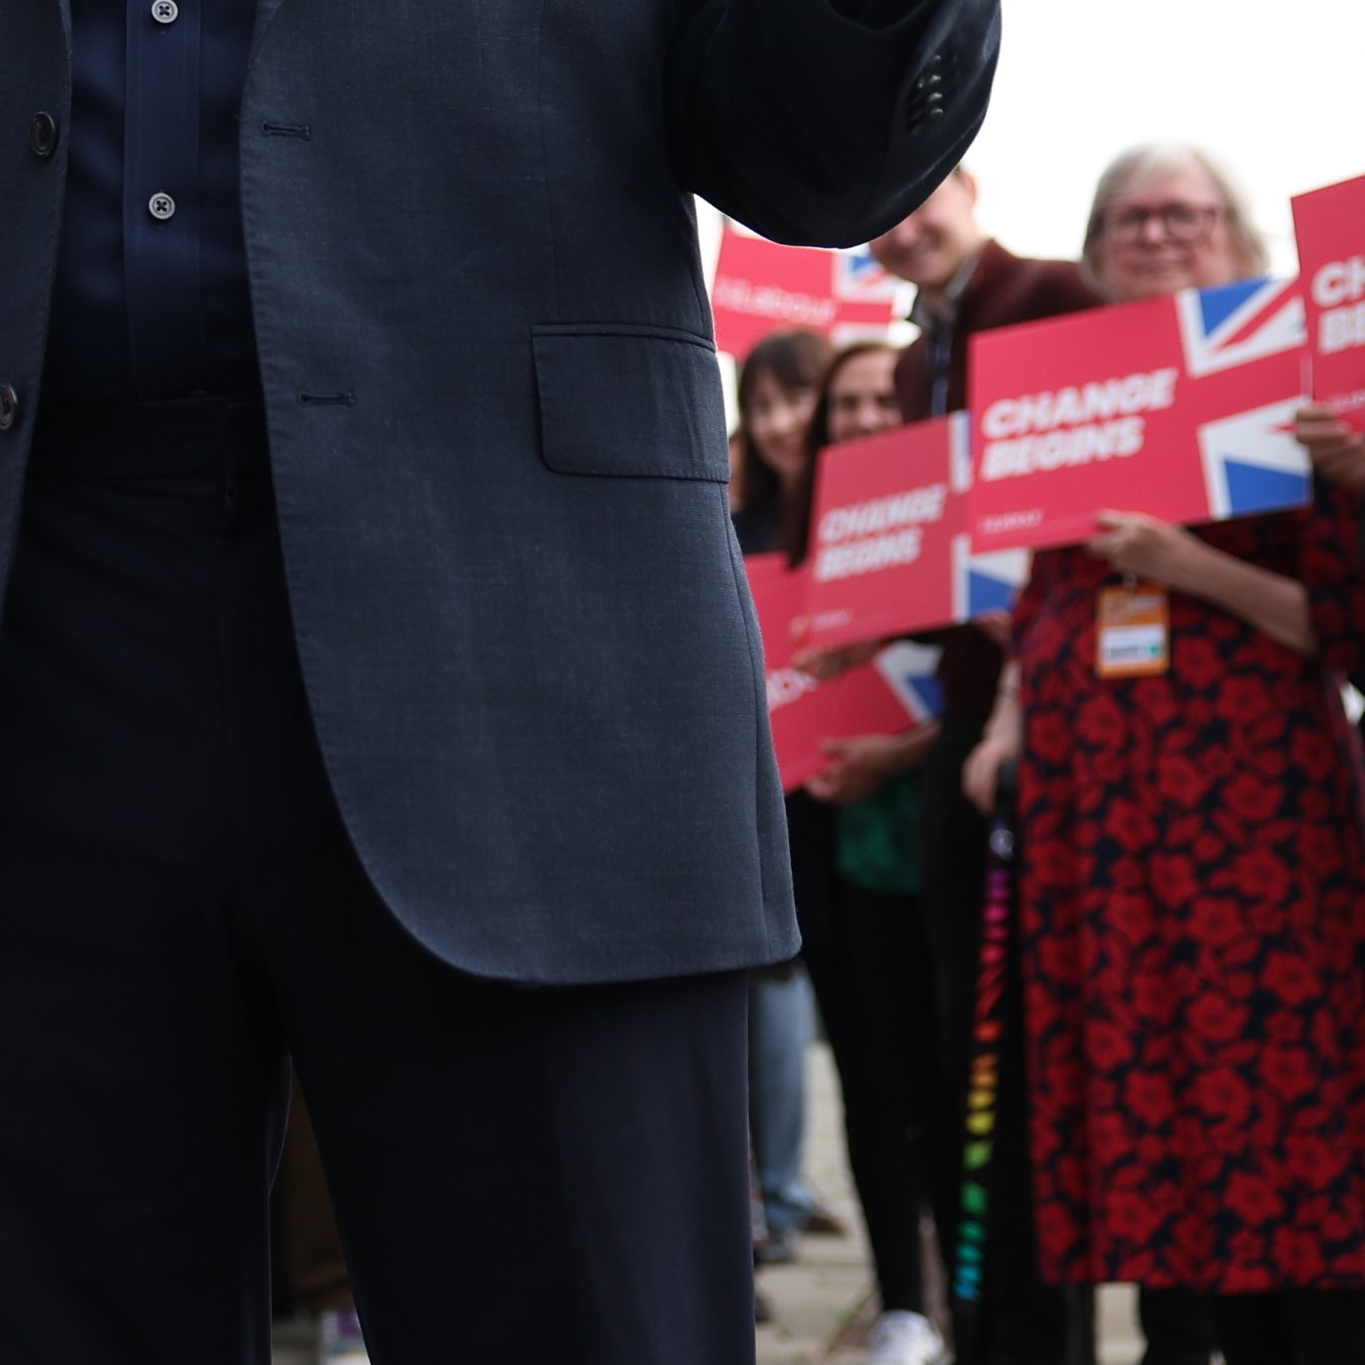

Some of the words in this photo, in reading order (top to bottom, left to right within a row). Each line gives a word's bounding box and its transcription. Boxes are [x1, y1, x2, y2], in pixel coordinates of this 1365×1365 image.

[982, 368, 1178, 439] CHANGE
[981, 415, 1144, 481] BEGINS
[819, 483, 946, 543] CHANGE
[814, 527, 923, 582] BEGINS
